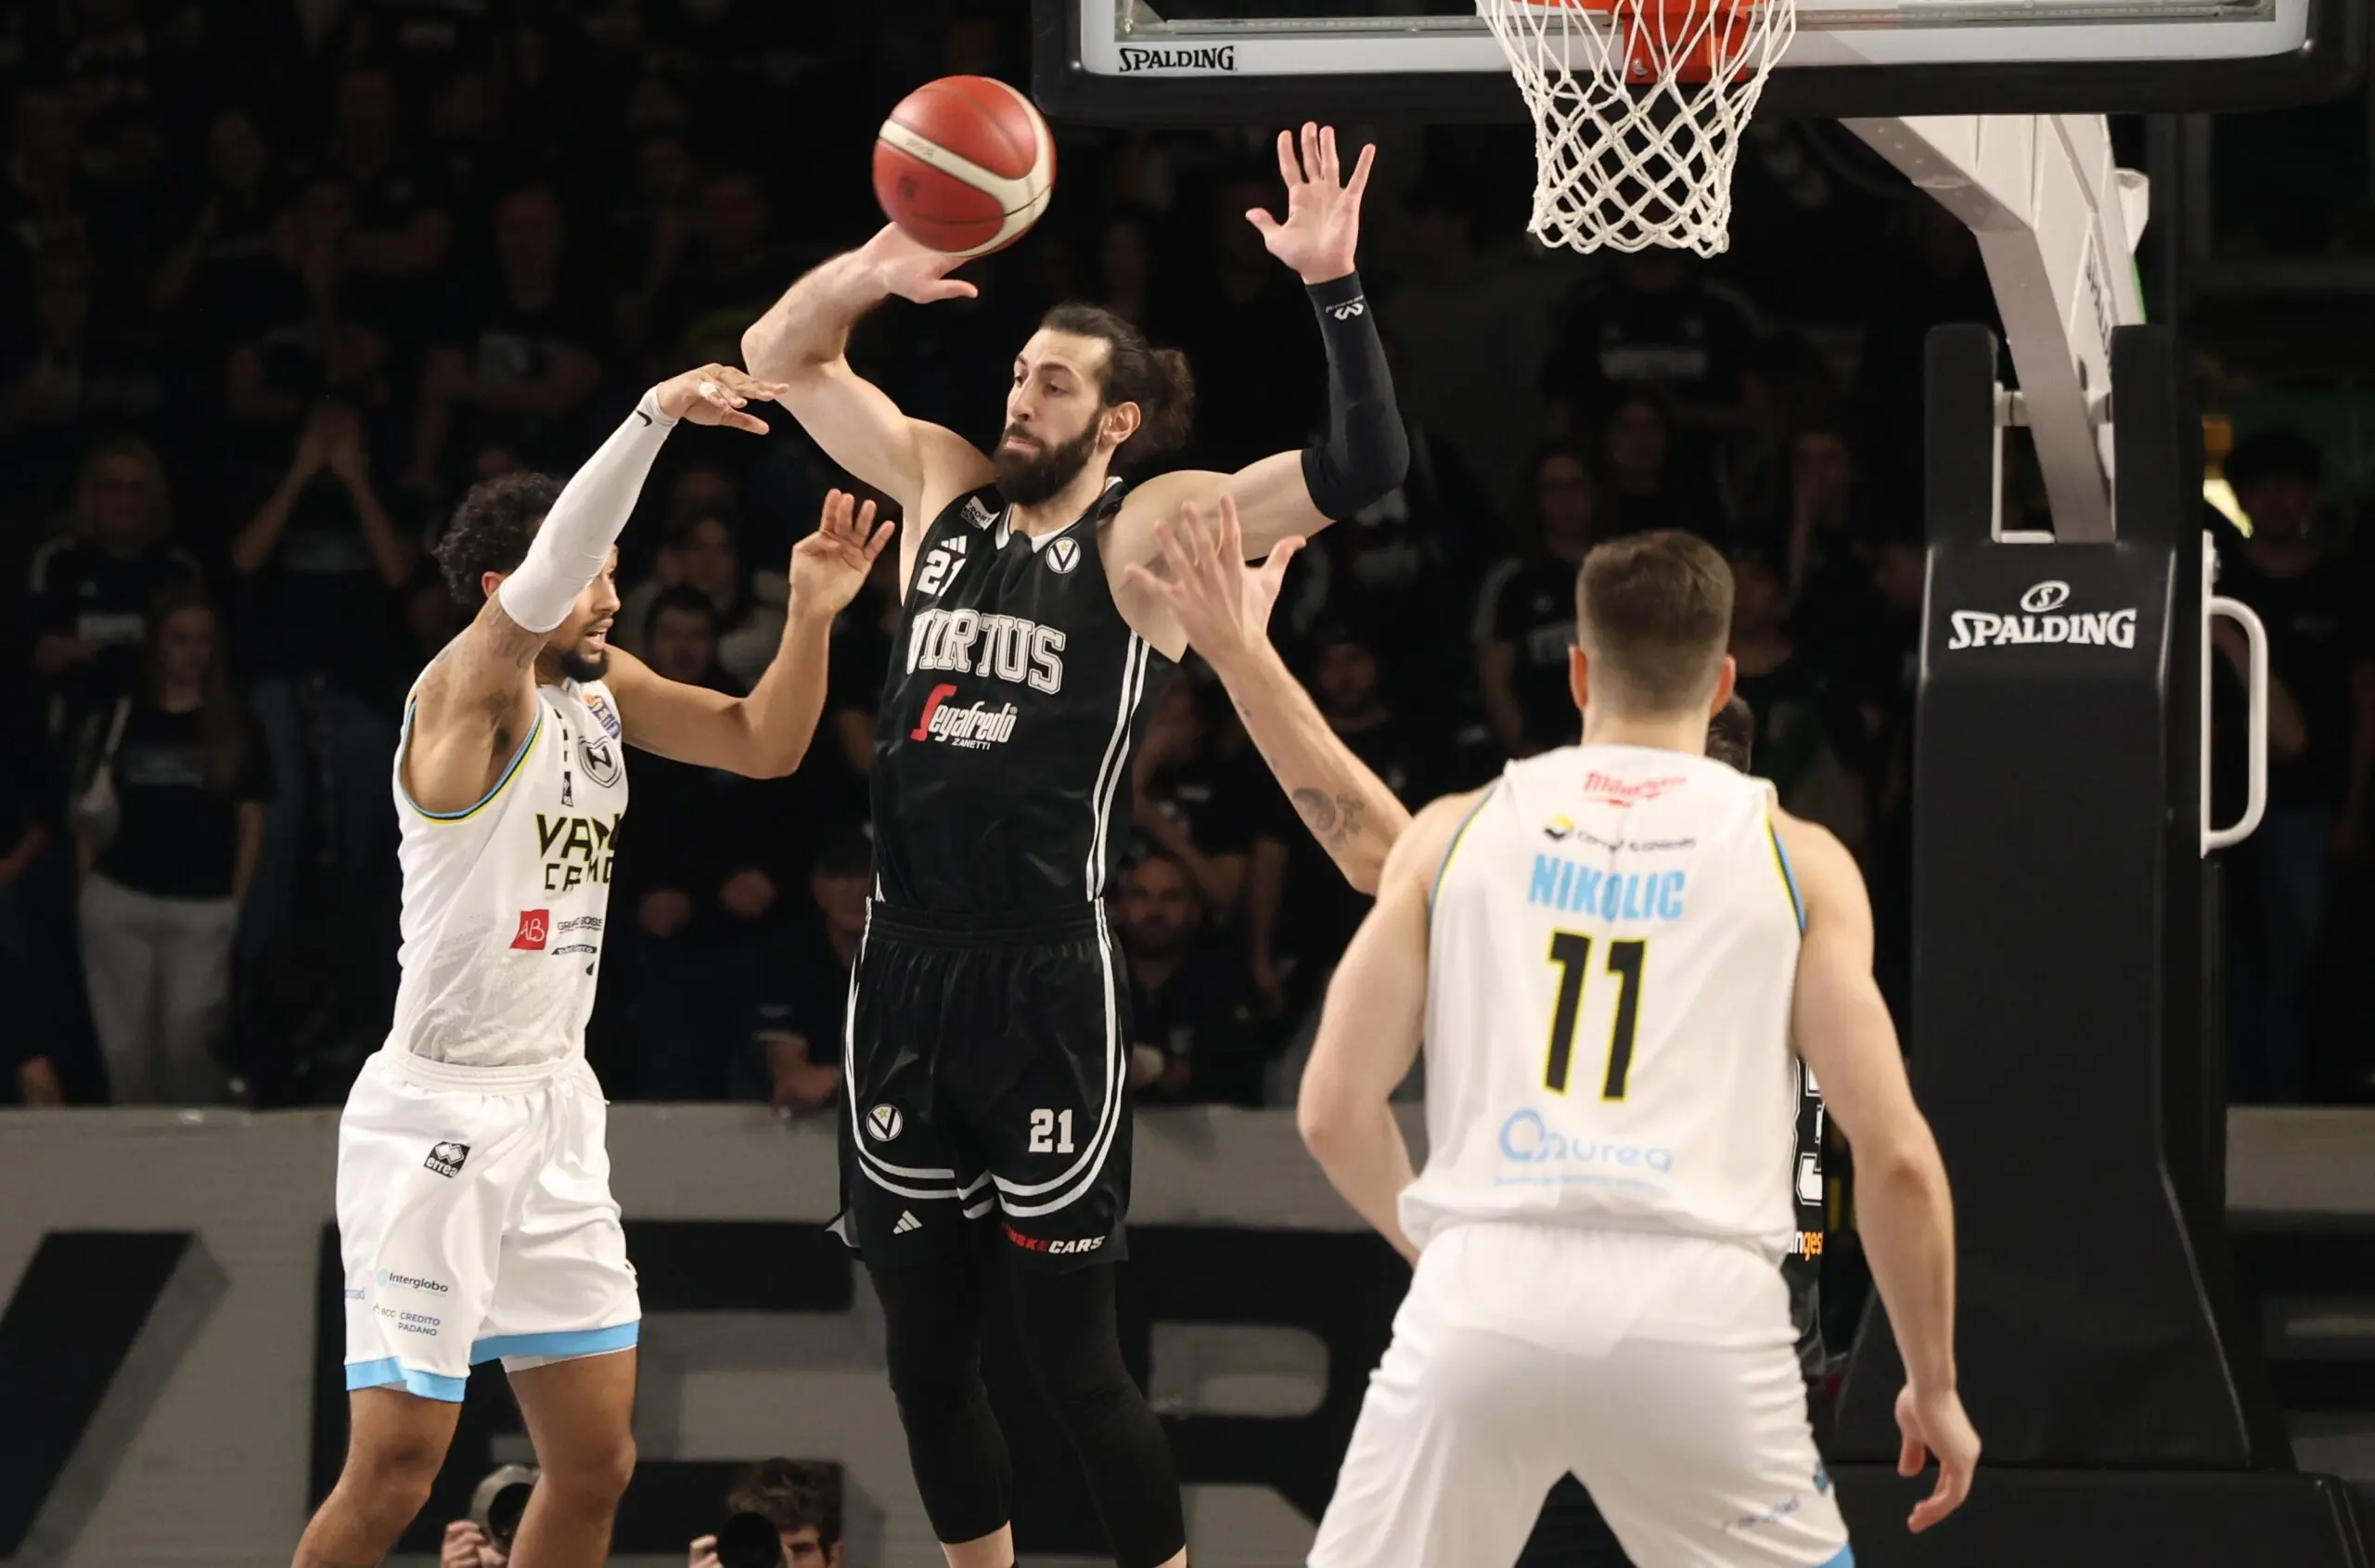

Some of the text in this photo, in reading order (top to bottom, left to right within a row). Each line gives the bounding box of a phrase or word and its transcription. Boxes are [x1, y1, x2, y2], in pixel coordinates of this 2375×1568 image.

[1119, 45, 1235, 72] SPALDING
[916, 548, 967, 598] 21
[1948, 608, 2138, 649] SPALDING
[952, 738, 991, 751] ZANETTI
[1527, 853, 1688, 922] NIKOLIC
[1543, 929, 1648, 1104] 11
[1028, 1109, 1074, 1153] 21
[390, 1272, 449, 1292] Interglobo
[398, 1322, 438, 1337] PADANO
[400, 1312, 441, 1327] CREDITO
